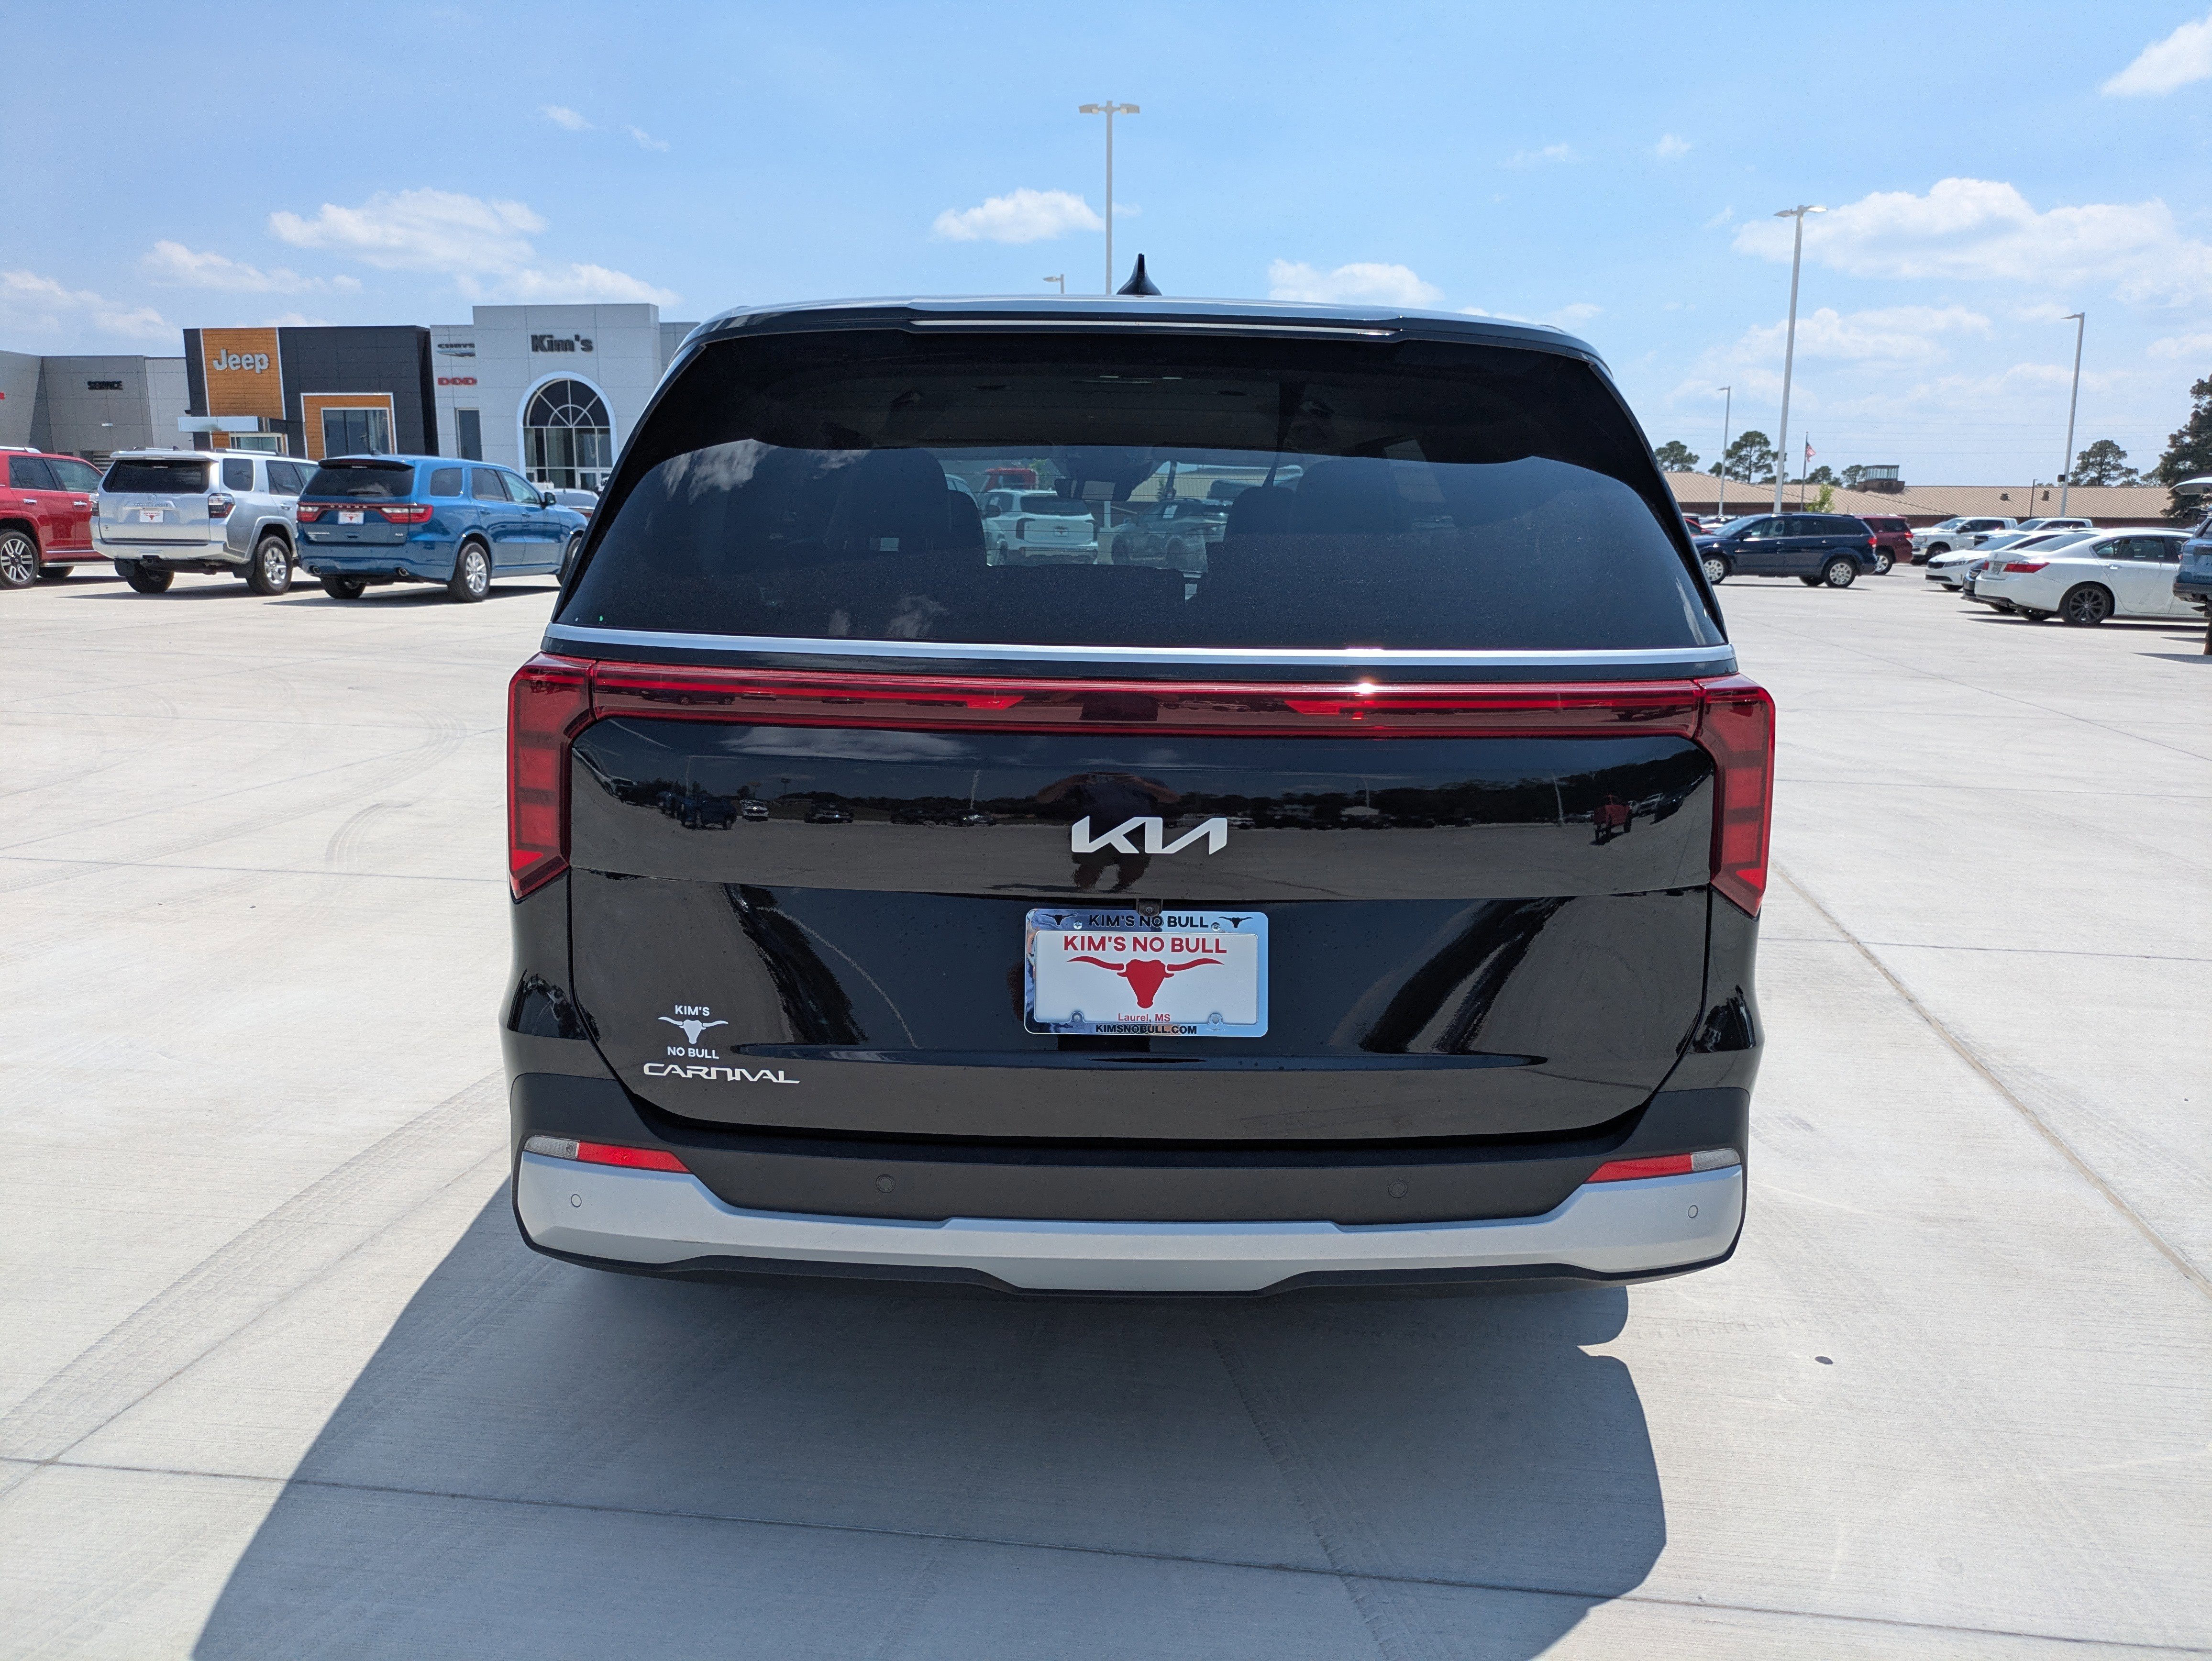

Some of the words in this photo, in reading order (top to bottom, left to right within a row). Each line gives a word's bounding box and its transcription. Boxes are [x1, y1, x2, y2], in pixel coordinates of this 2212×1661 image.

[531, 334, 594, 352] Kim's
[212, 348, 269, 374] Jeep
[1072, 815, 1228, 855] KIA
[1089, 914, 1135, 927] KIM'S
[1139, 916, 1164, 928] NO
[1167, 916, 1209, 928] BULL
[1064, 935, 1126, 952] KIM'S
[1132, 937, 1165, 952] NO
[1171, 938, 1227, 954] BULL
[675, 1005, 710, 1016] KIM'S
[1118, 1013, 1151, 1023] Laurel,
[1155, 1014, 1171, 1022] MS
[1095, 1024, 1197, 1034] KIMSNOBULL.COM
[667, 1046, 685, 1056] NO
[688, 1048, 719, 1059] BULL
[643, 1063, 800, 1084] CARNIVAL
